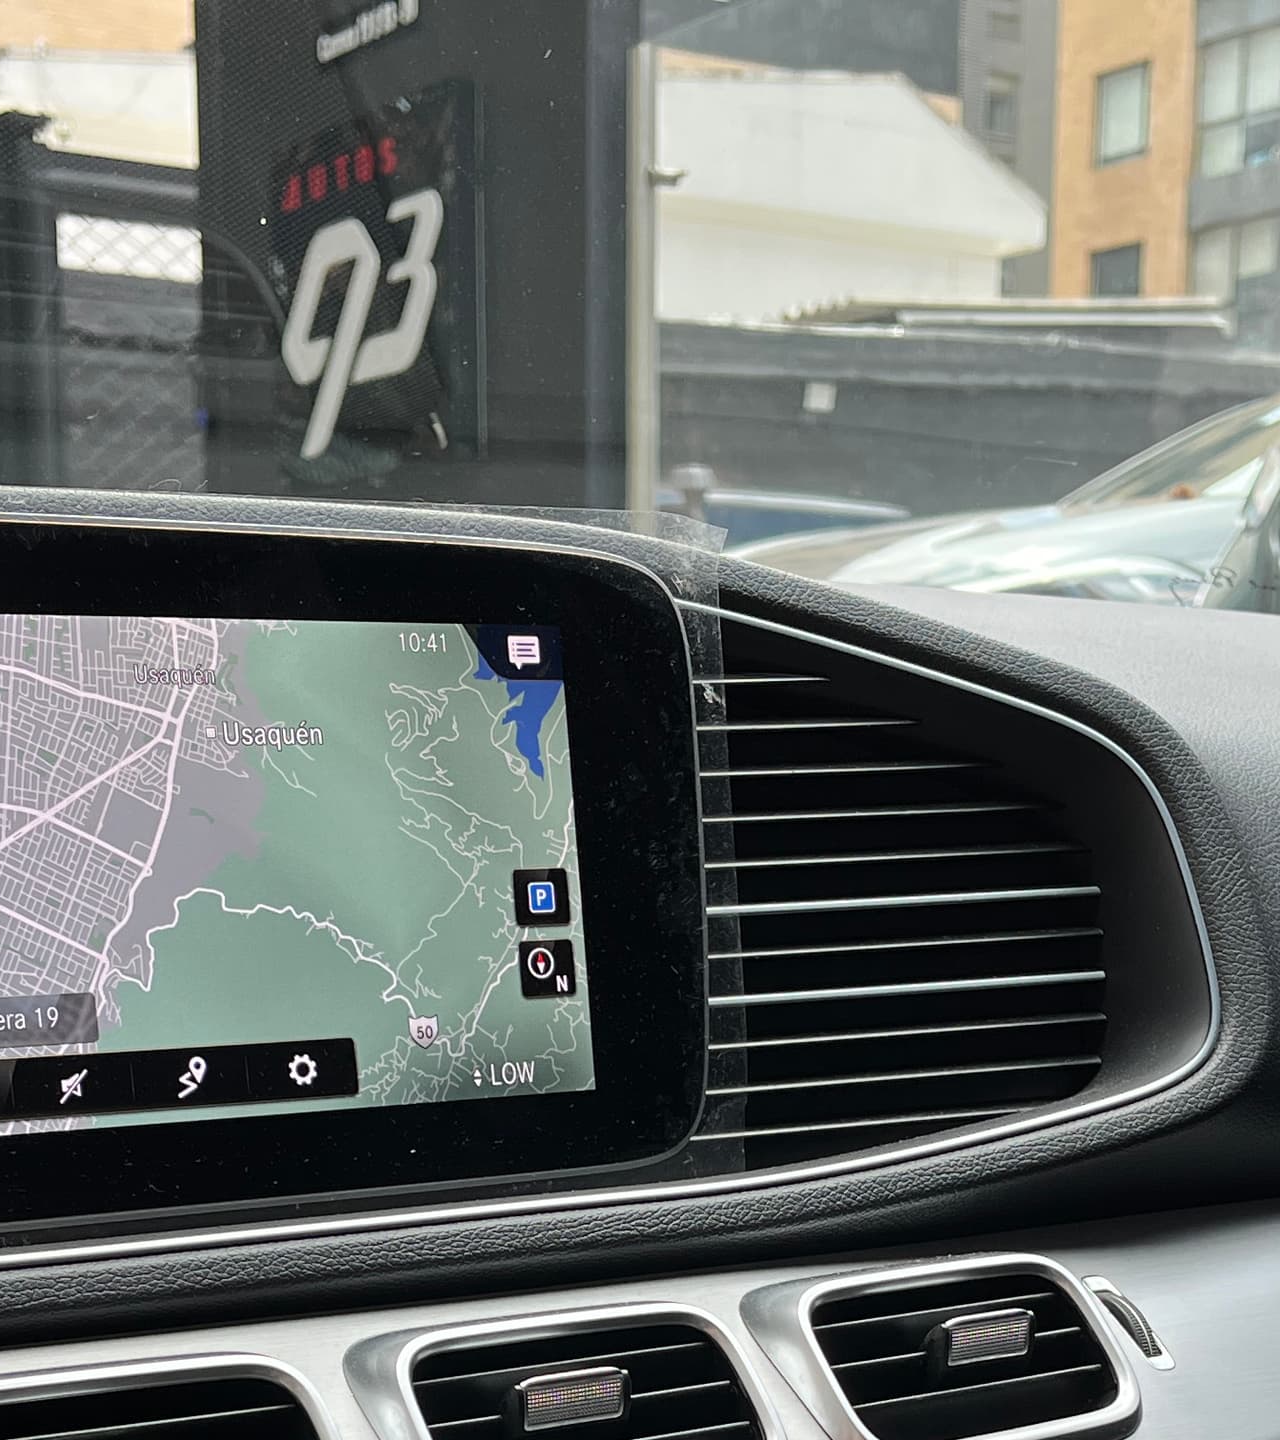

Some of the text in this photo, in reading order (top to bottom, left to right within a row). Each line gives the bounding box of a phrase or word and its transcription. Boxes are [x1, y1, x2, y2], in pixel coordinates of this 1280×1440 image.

[280, 136, 399, 213] AUTOS
[281, 187, 444, 460] 93
[399, 632, 447, 653] 10:41
[133, 664, 216, 688] Usaquén
[222, 721, 324, 751] Usaquén
[556, 975, 569, 992] N
[34, 1006, 59, 1028] 19
[416, 1025, 434, 1040] 50
[490, 1060, 536, 1087] LOW
